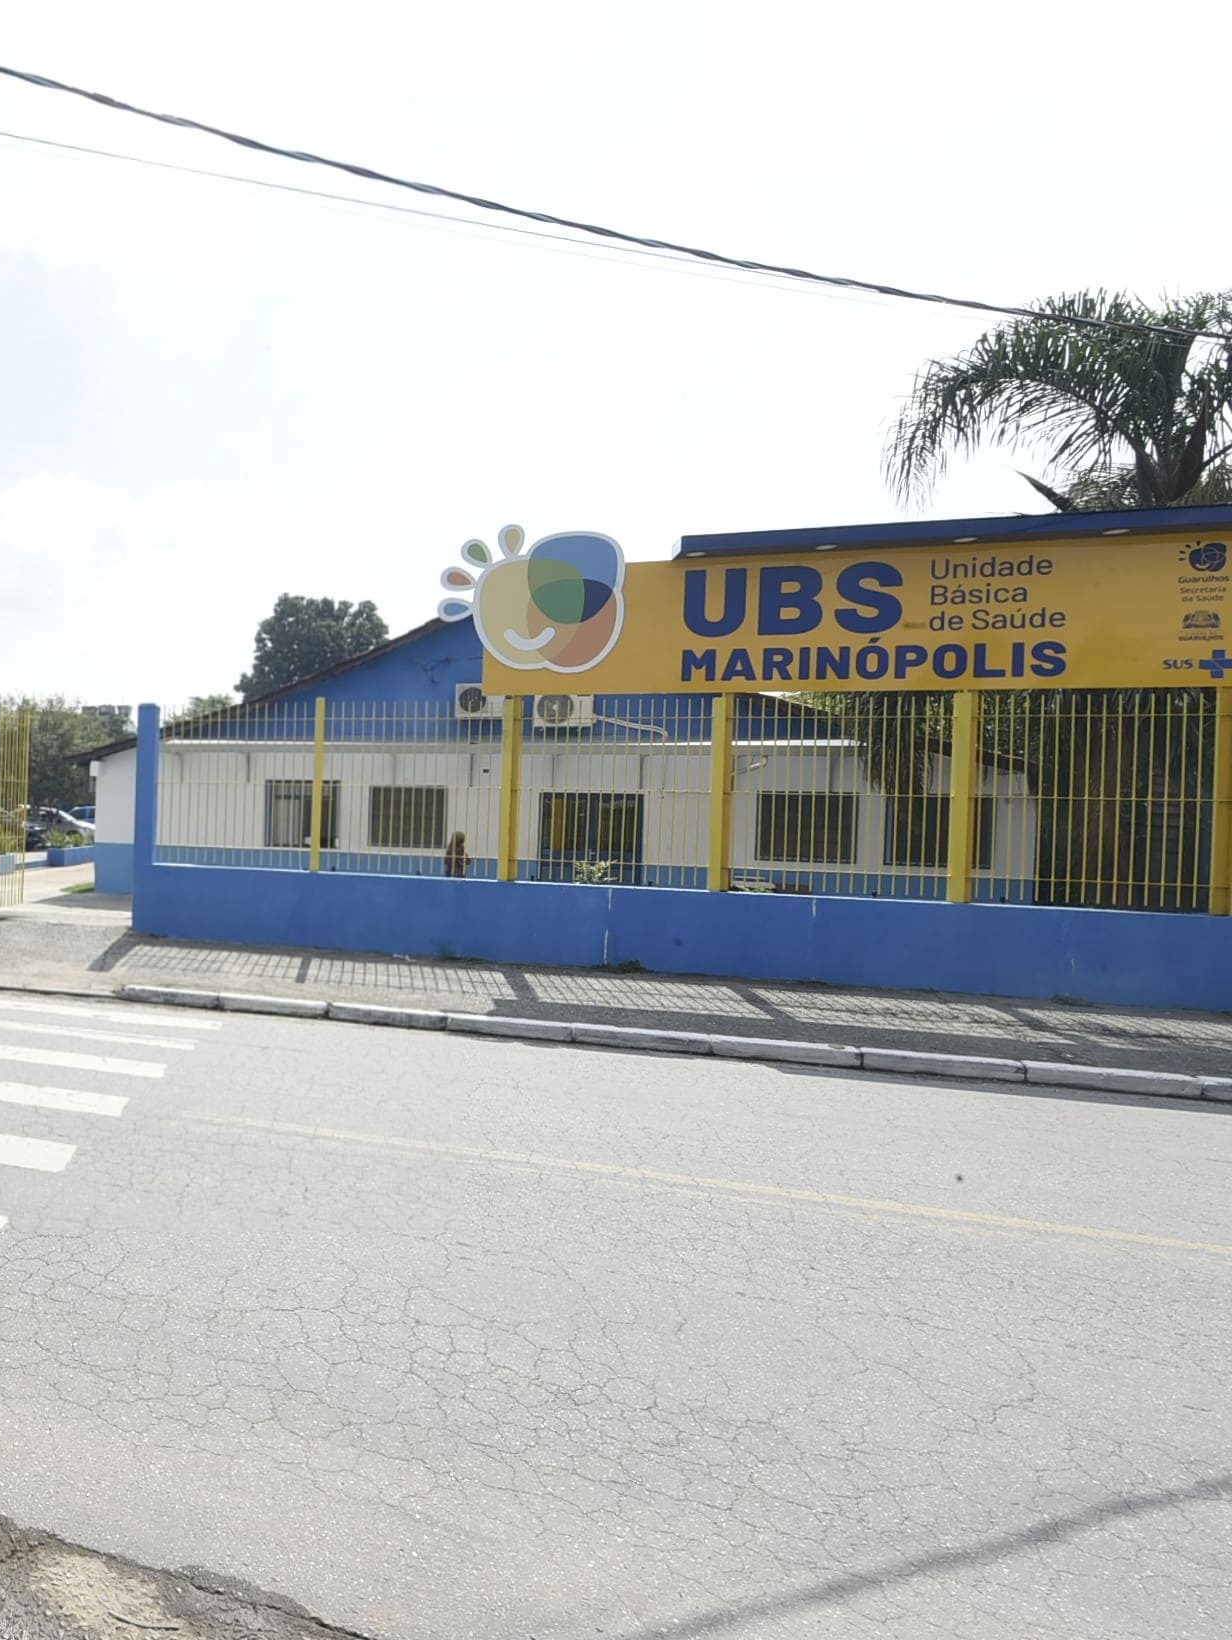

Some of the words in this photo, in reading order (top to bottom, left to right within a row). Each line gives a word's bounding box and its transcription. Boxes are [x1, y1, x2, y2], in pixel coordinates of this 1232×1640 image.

[931, 554, 1053, 580] Unidade
[1178, 575, 1230, 584] Guarulhos
[1179, 586, 1227, 594] Secretaria
[683, 561, 903, 638] UBS
[930, 582, 1028, 606] Básica
[1181, 594, 1193, 602] de
[1196, 594, 1224, 602] Saúde
[929, 610, 964, 632] de
[971, 607, 1066, 631] Saúde
[680, 637, 1067, 682] MARINÓPOLIS
[1162, 658, 1194, 670] SUS
